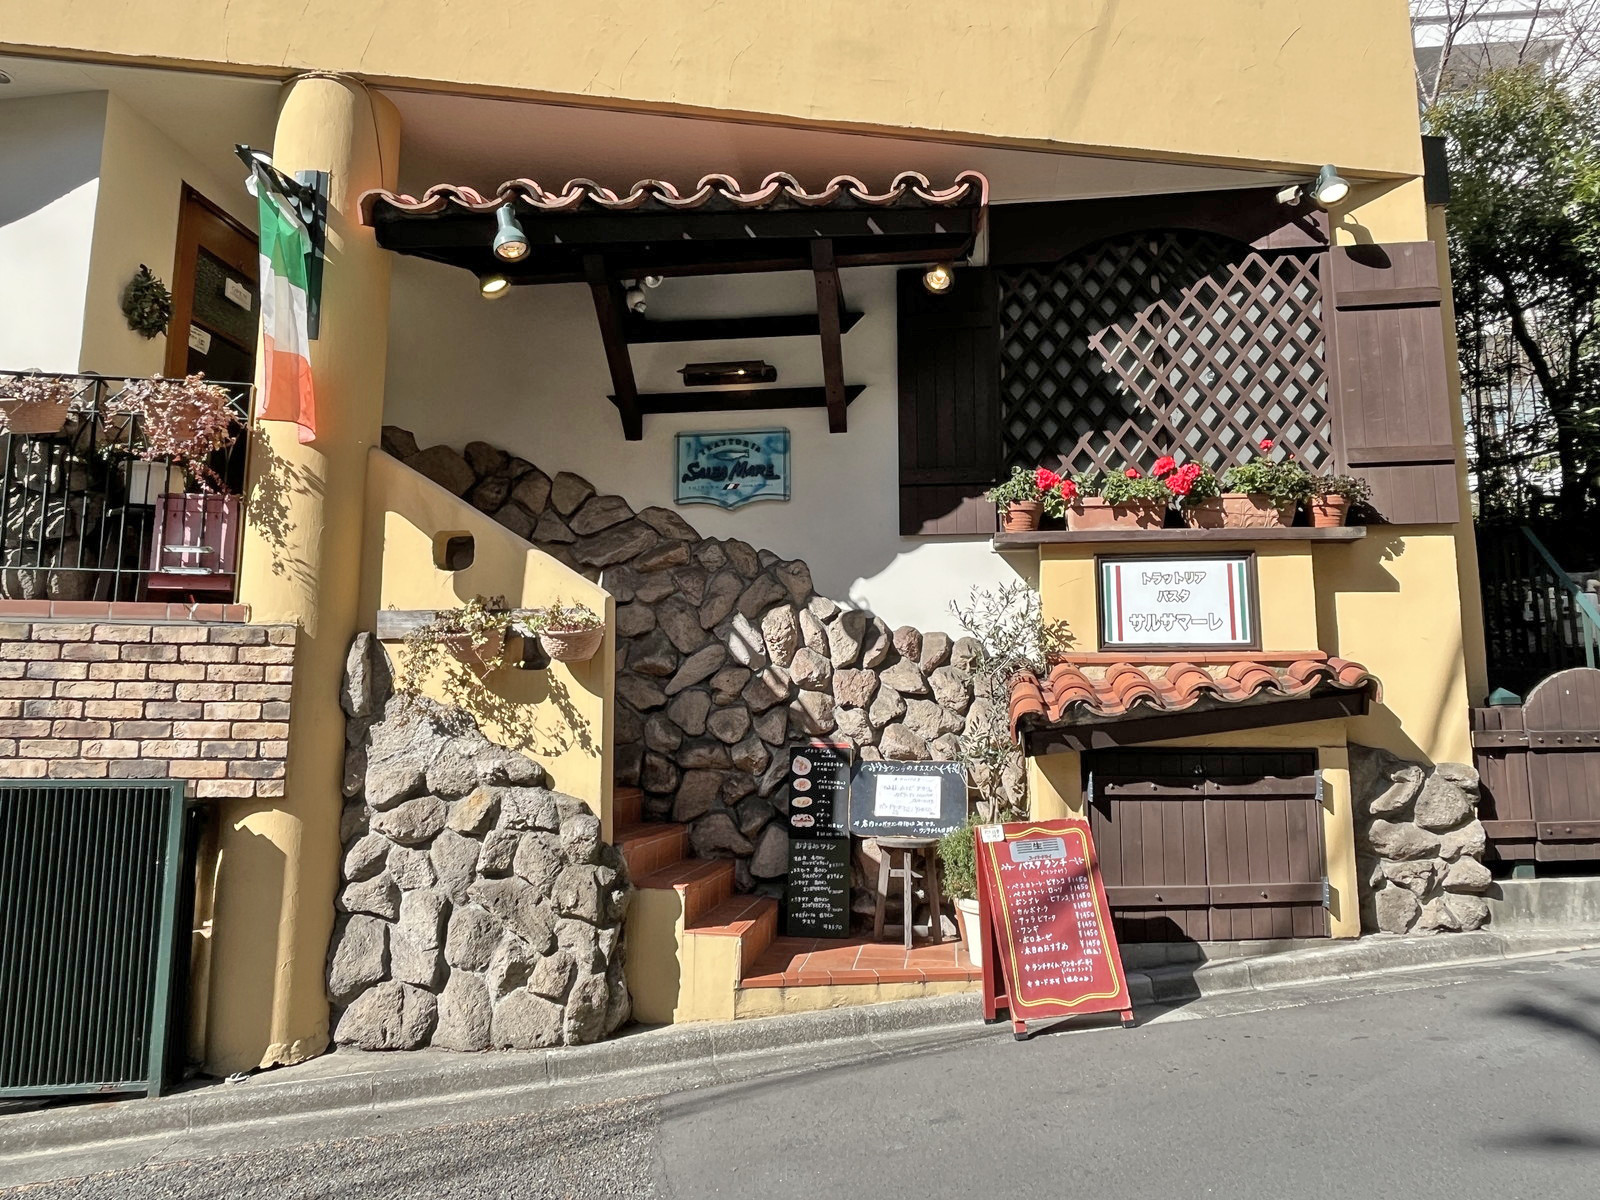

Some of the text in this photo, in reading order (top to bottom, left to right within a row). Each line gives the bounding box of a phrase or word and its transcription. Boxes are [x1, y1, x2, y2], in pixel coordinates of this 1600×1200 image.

[700, 438, 762, 455] TRATTORIA
[1142, 571, 1207, 585] トラットリア
[1157, 589, 1191, 602] パスタ
[1129, 612, 1223, 632] サルサマーレ
[1019, 858, 1067, 870] パスタ ランチ
[1024, 943, 1069, 955] 本日のおすすめ
